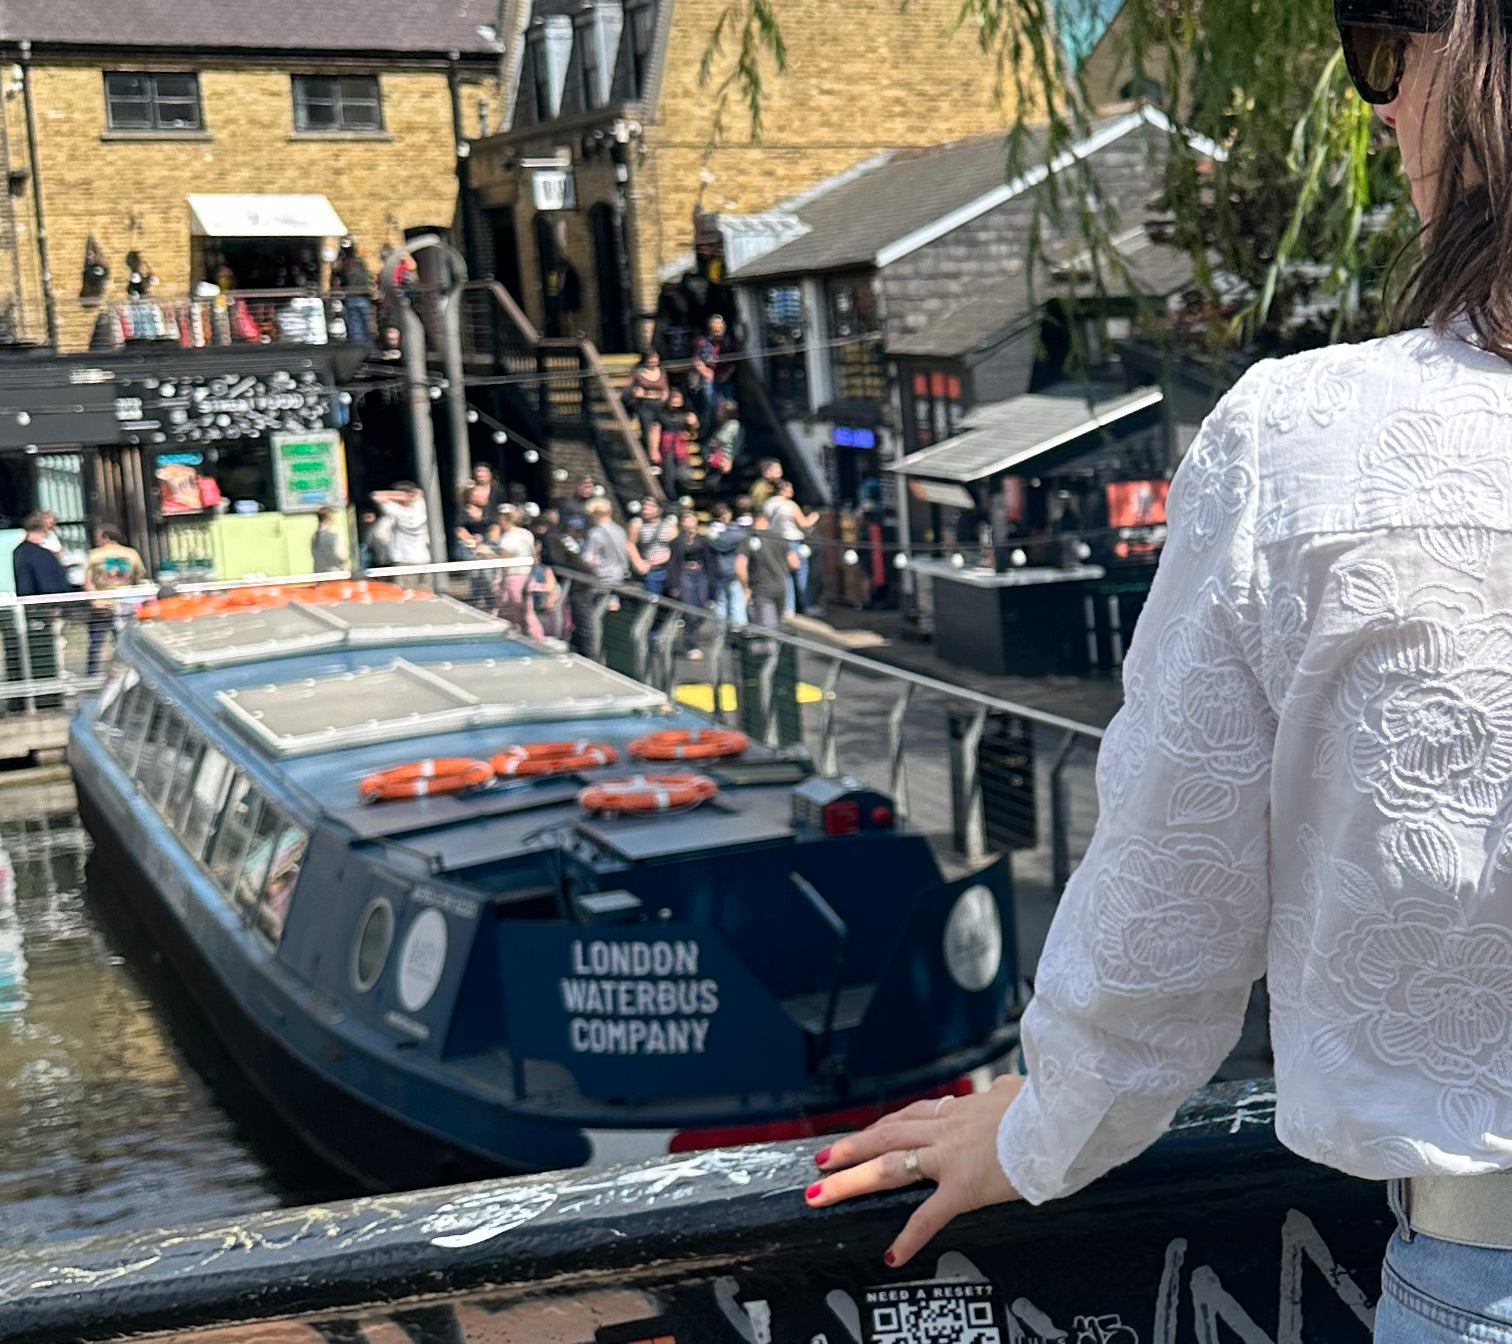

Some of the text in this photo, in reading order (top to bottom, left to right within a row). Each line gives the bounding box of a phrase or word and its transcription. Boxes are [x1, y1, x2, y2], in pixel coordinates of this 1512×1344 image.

[572, 939, 700, 977] LONDON
[560, 978, 720, 1015] WATERBUS
[571, 1017, 711, 1055] COMPANY
[866, 1285, 994, 1303] NEED A RESET?
